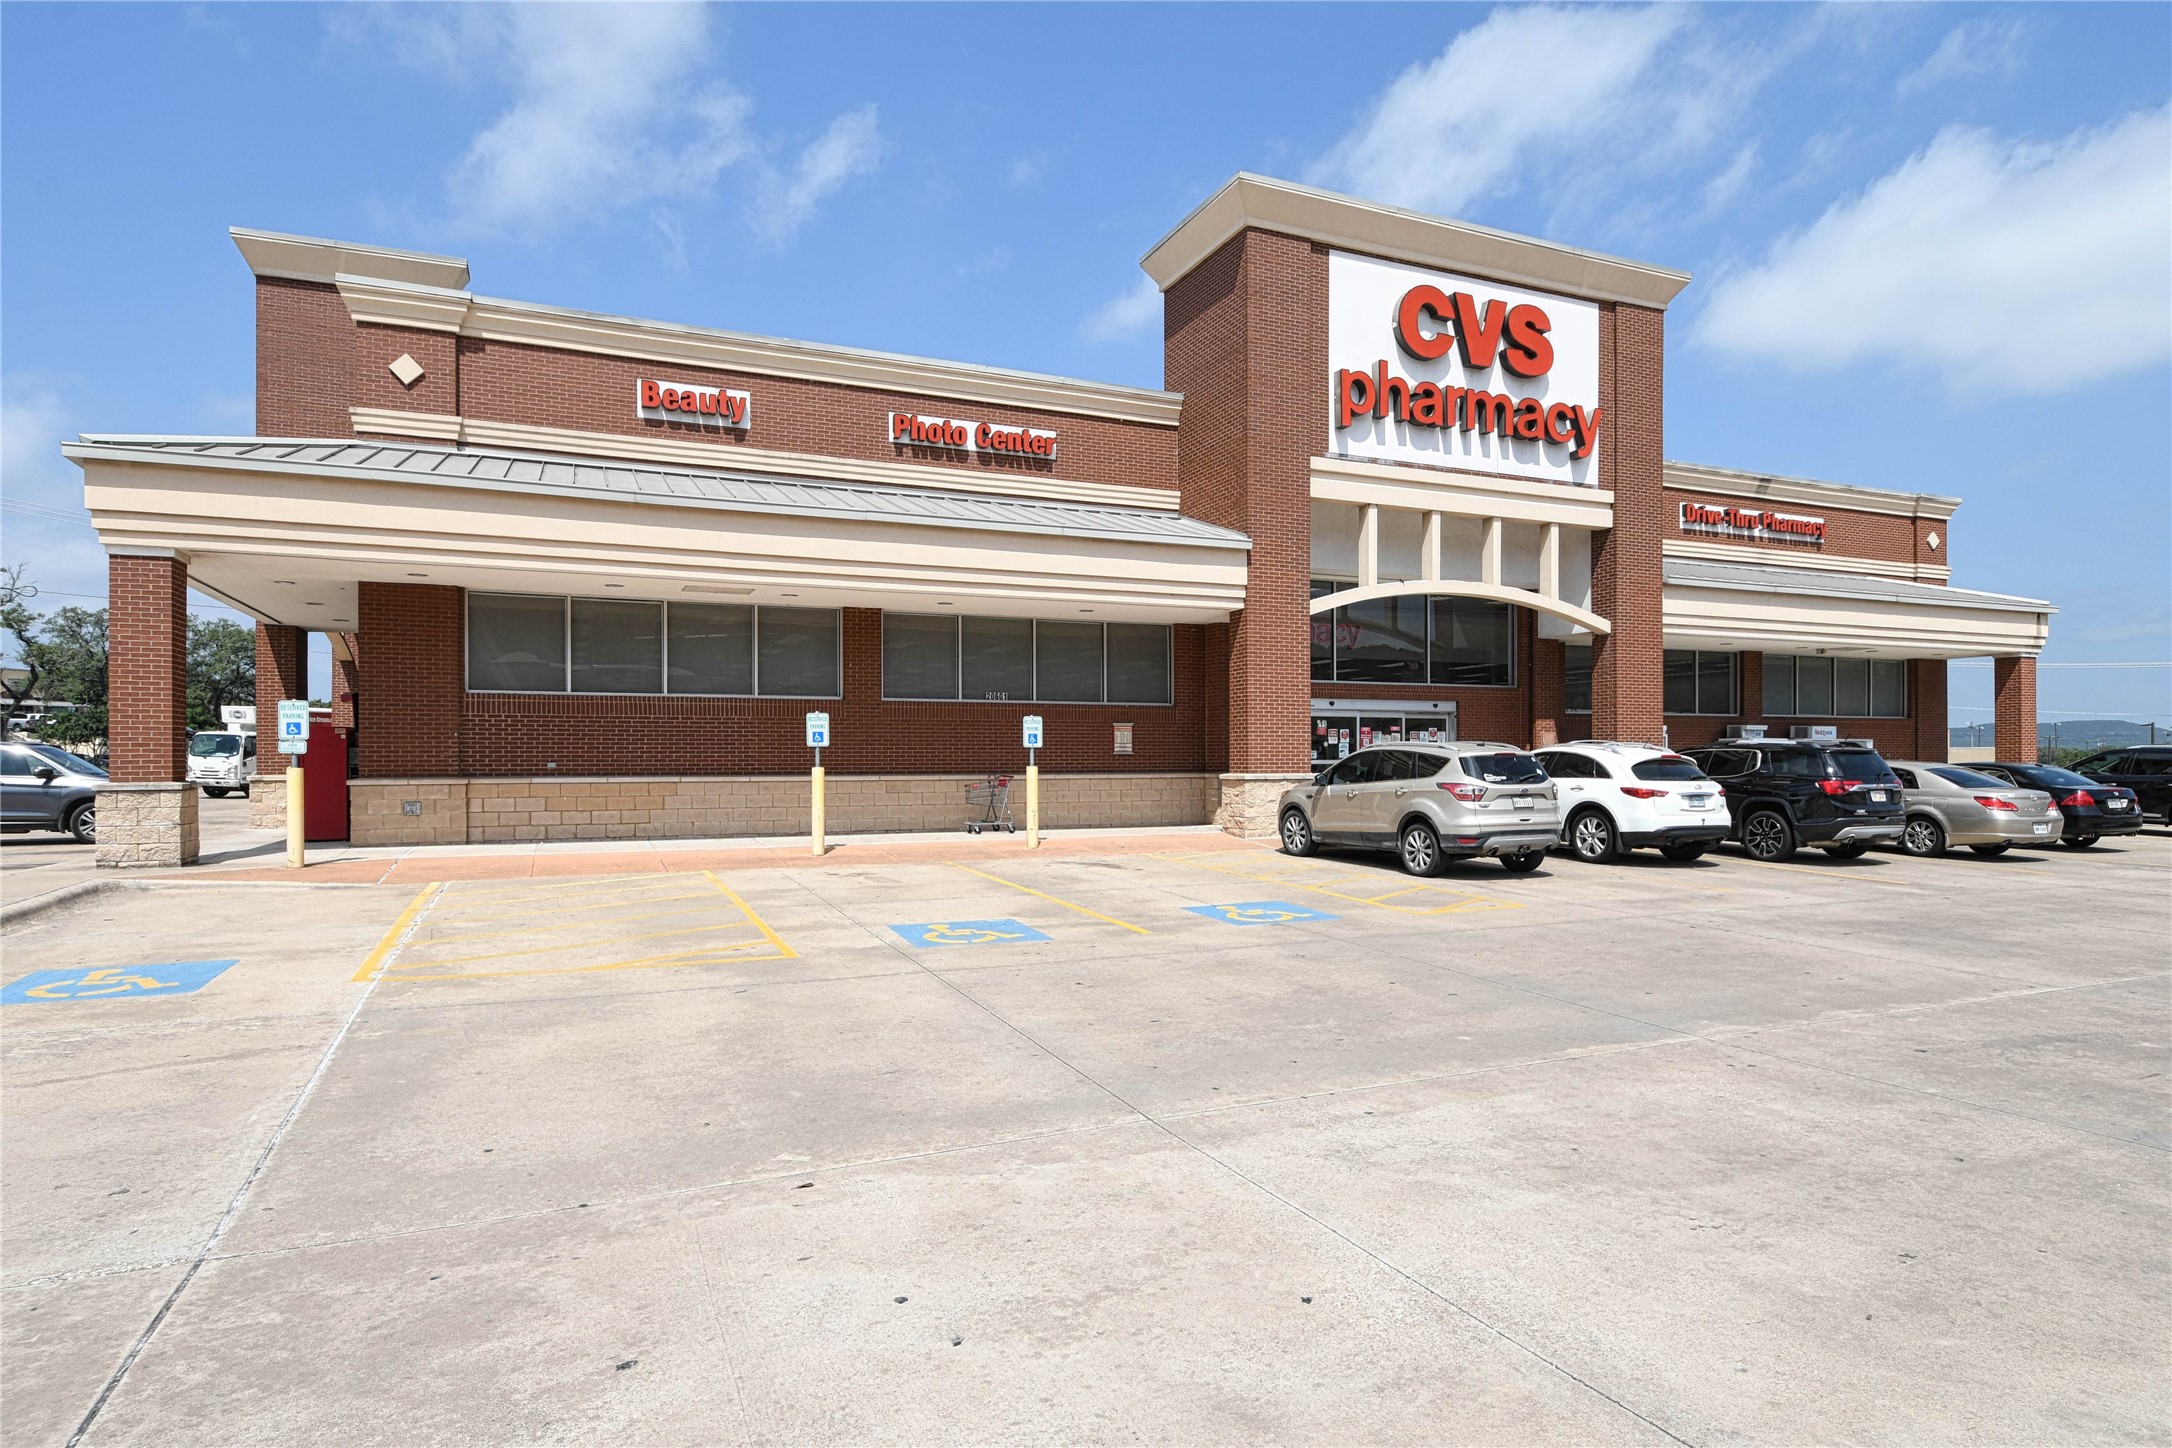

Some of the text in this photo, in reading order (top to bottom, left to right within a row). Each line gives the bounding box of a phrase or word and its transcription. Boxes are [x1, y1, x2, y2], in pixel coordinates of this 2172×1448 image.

[1393, 284, 1554, 378] CVS
[640, 380, 747, 424] Beauty
[1334, 359, 1601, 460] pharmacy
[893, 413, 1057, 456] Photo Center
[1685, 503, 1828, 539] Drive-Thru Pharmacy
